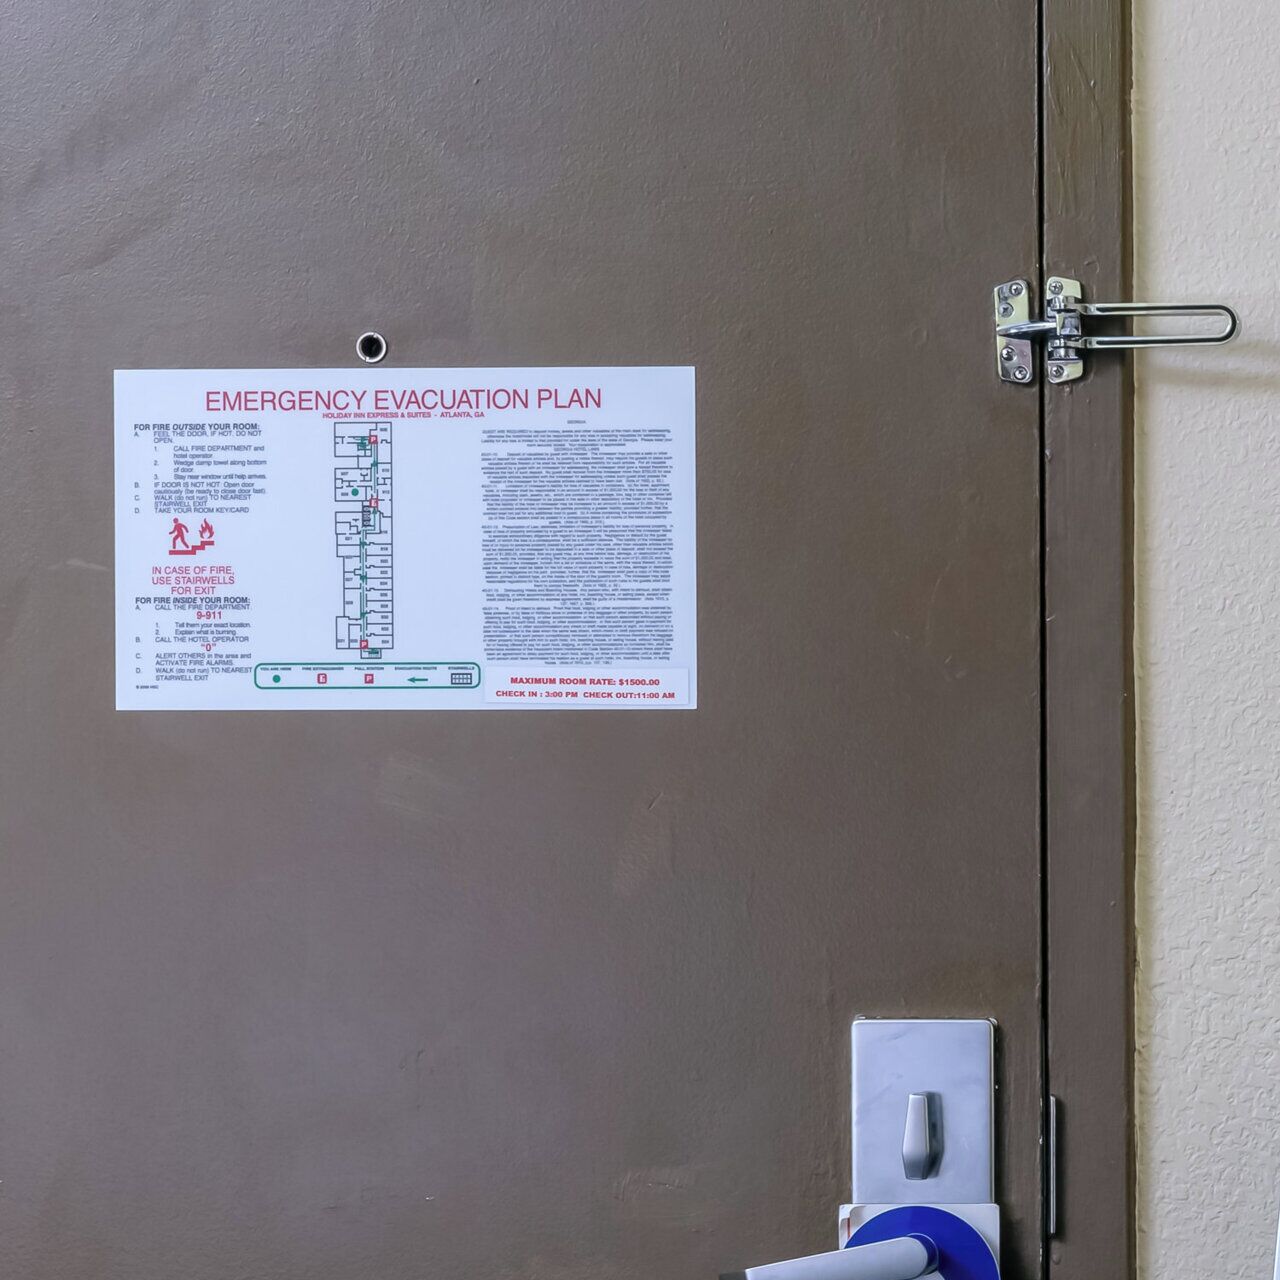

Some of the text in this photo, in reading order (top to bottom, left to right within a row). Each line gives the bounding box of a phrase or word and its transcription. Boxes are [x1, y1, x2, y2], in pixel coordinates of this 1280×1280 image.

[206, 388, 602, 411] EMERGENCY EVACUATION PLAN
[152, 567, 234, 575] IN CASE OF FIRE,
[152, 576, 235, 584] USE STAIRWELLS
[197, 611, 222, 619] 9-911
[559, 677, 586, 685] ROOM
